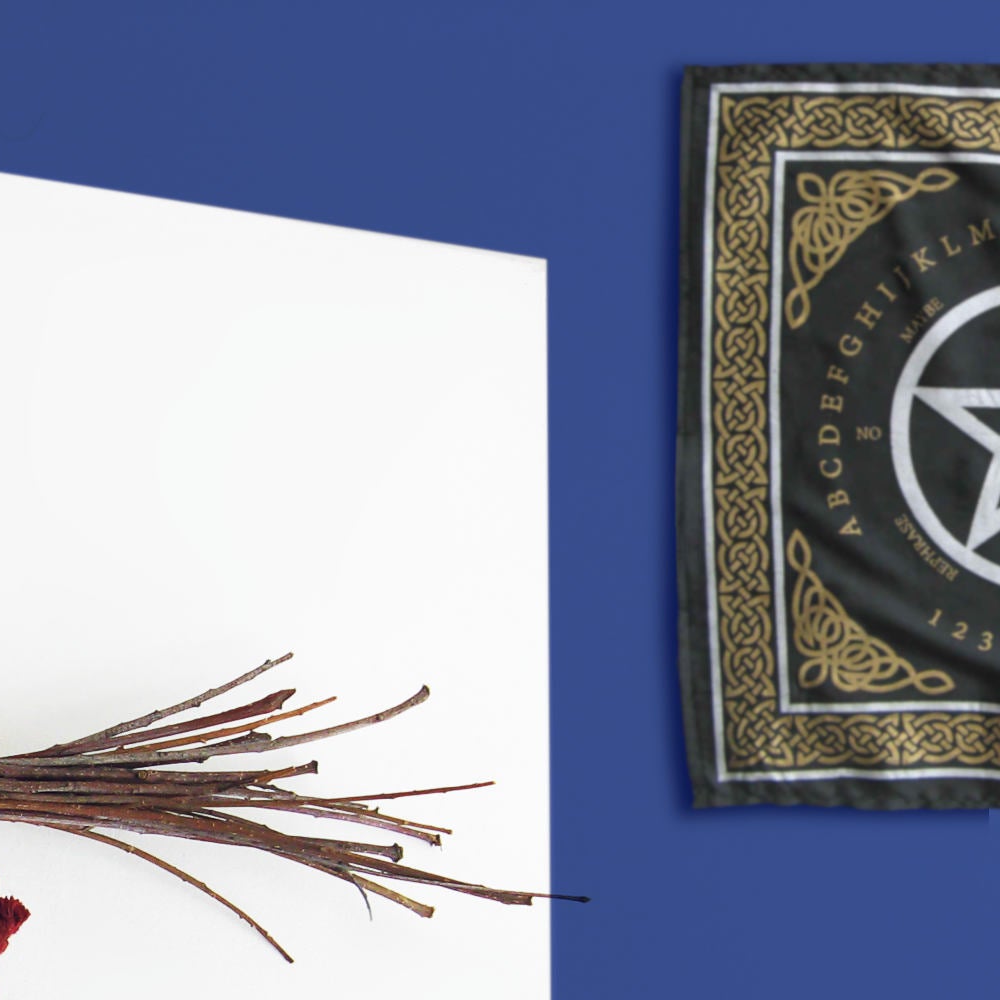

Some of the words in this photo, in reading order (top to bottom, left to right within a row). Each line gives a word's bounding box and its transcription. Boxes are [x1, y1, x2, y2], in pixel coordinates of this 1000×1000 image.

[899, 297, 944, 343] MAYBE
[856, 427, 882, 439] NO
[894, 514, 959, 581] REPHRASE
[928, 609, 943, 626] 1
[952, 621, 968, 640] 2
[978, 631, 994, 651] 3
